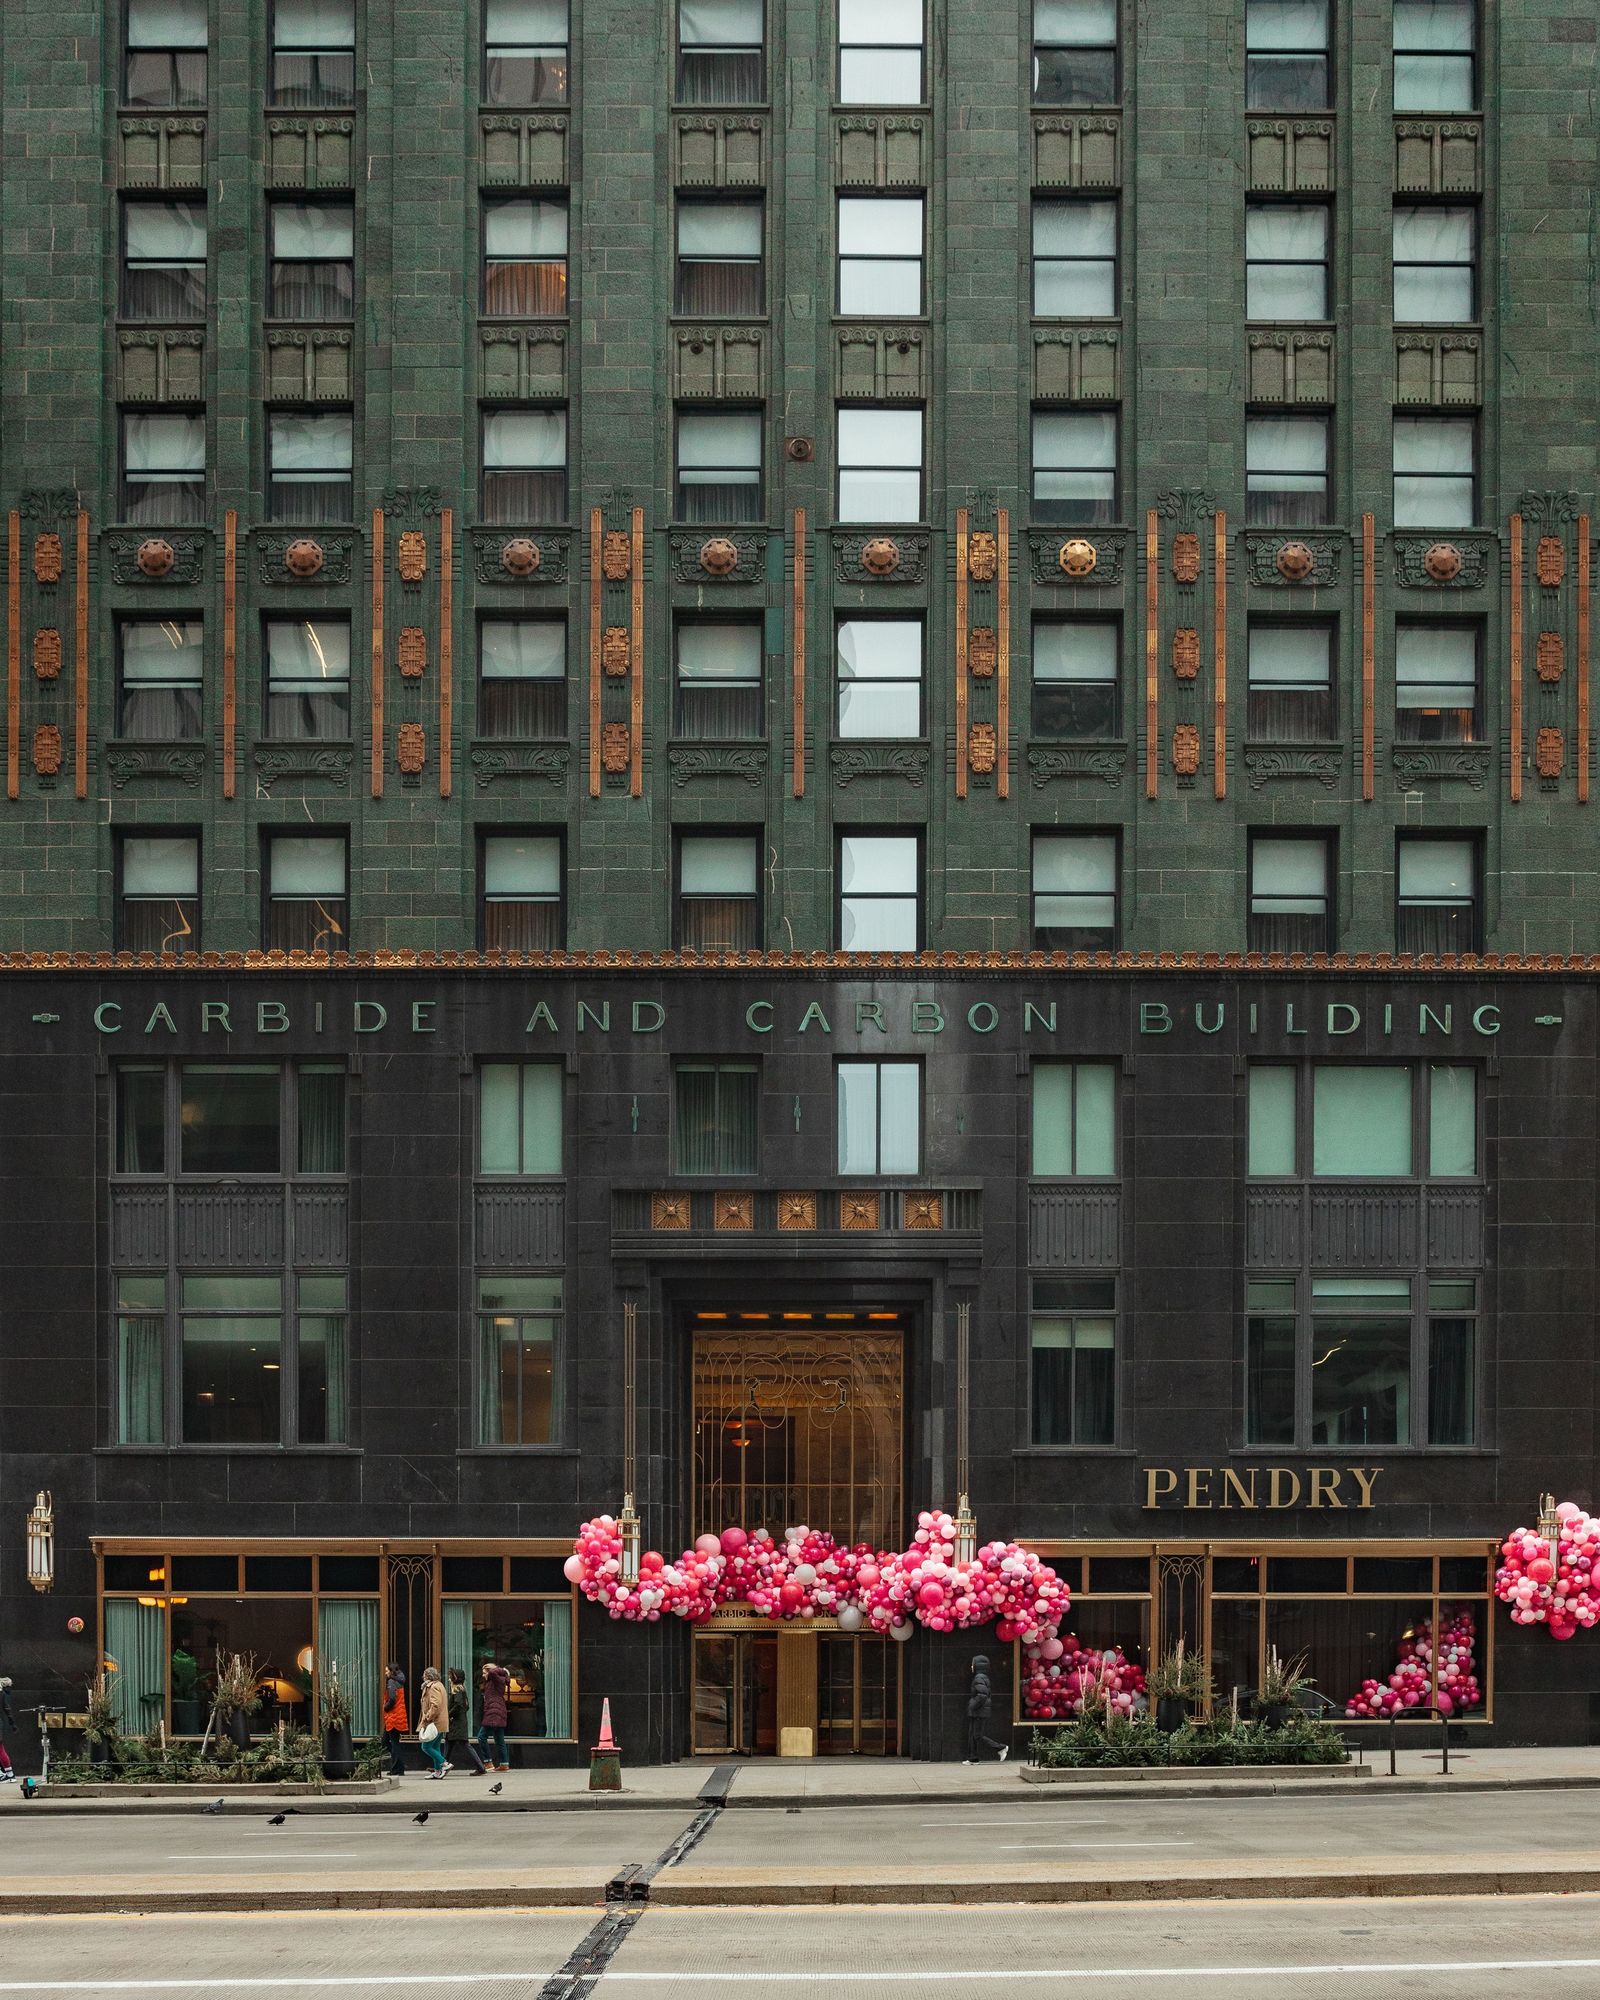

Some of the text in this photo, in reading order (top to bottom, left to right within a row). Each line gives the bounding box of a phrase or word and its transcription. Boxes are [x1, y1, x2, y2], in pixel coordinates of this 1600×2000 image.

[93, 1001, 1501, 1034] CARBIDE AND CARBON BUILDING
[1142, 1468, 1384, 1509] PENDRY
[713, 1609, 750, 1618] ARBIDE
